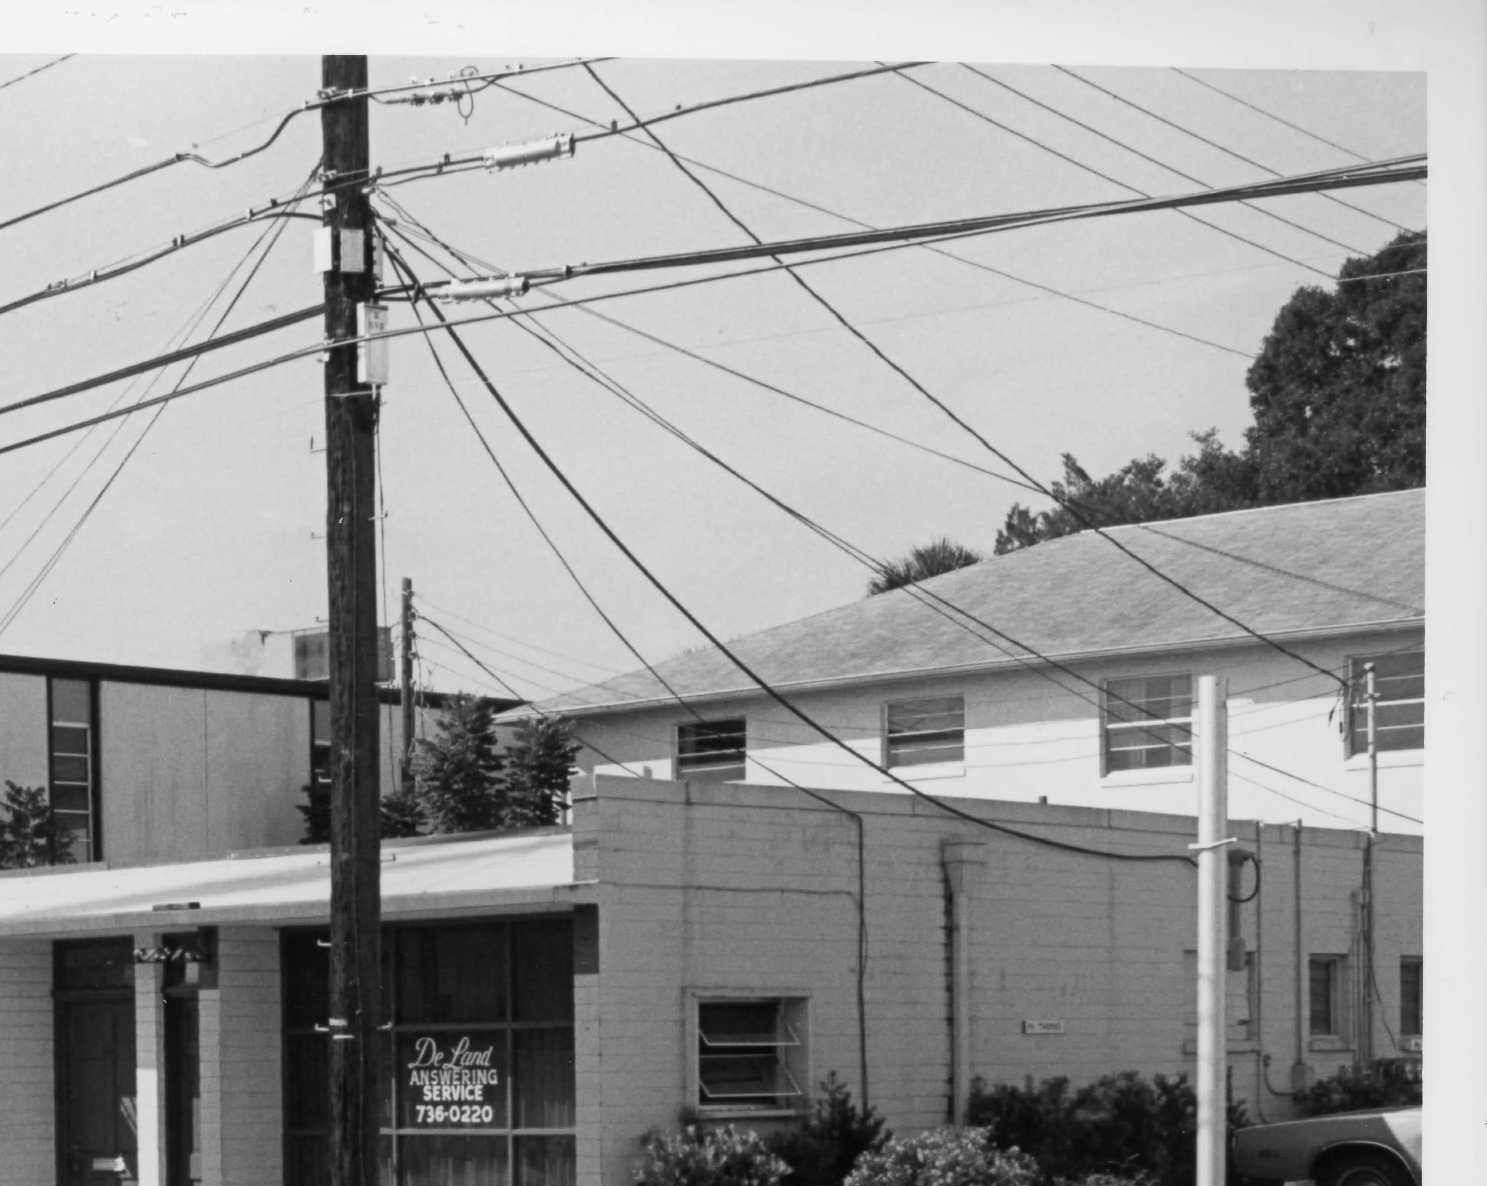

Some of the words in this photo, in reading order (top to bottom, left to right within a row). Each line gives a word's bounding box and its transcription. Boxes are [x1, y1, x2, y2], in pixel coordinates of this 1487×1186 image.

[407, 1036, 444, 1069] De
[442, 1036, 494, 1070] Land
[409, 1069, 498, 1086] ANSWERING
[423, 1085, 484, 1101] SERVICE
[415, 1105, 493, 1123] 736-0220
